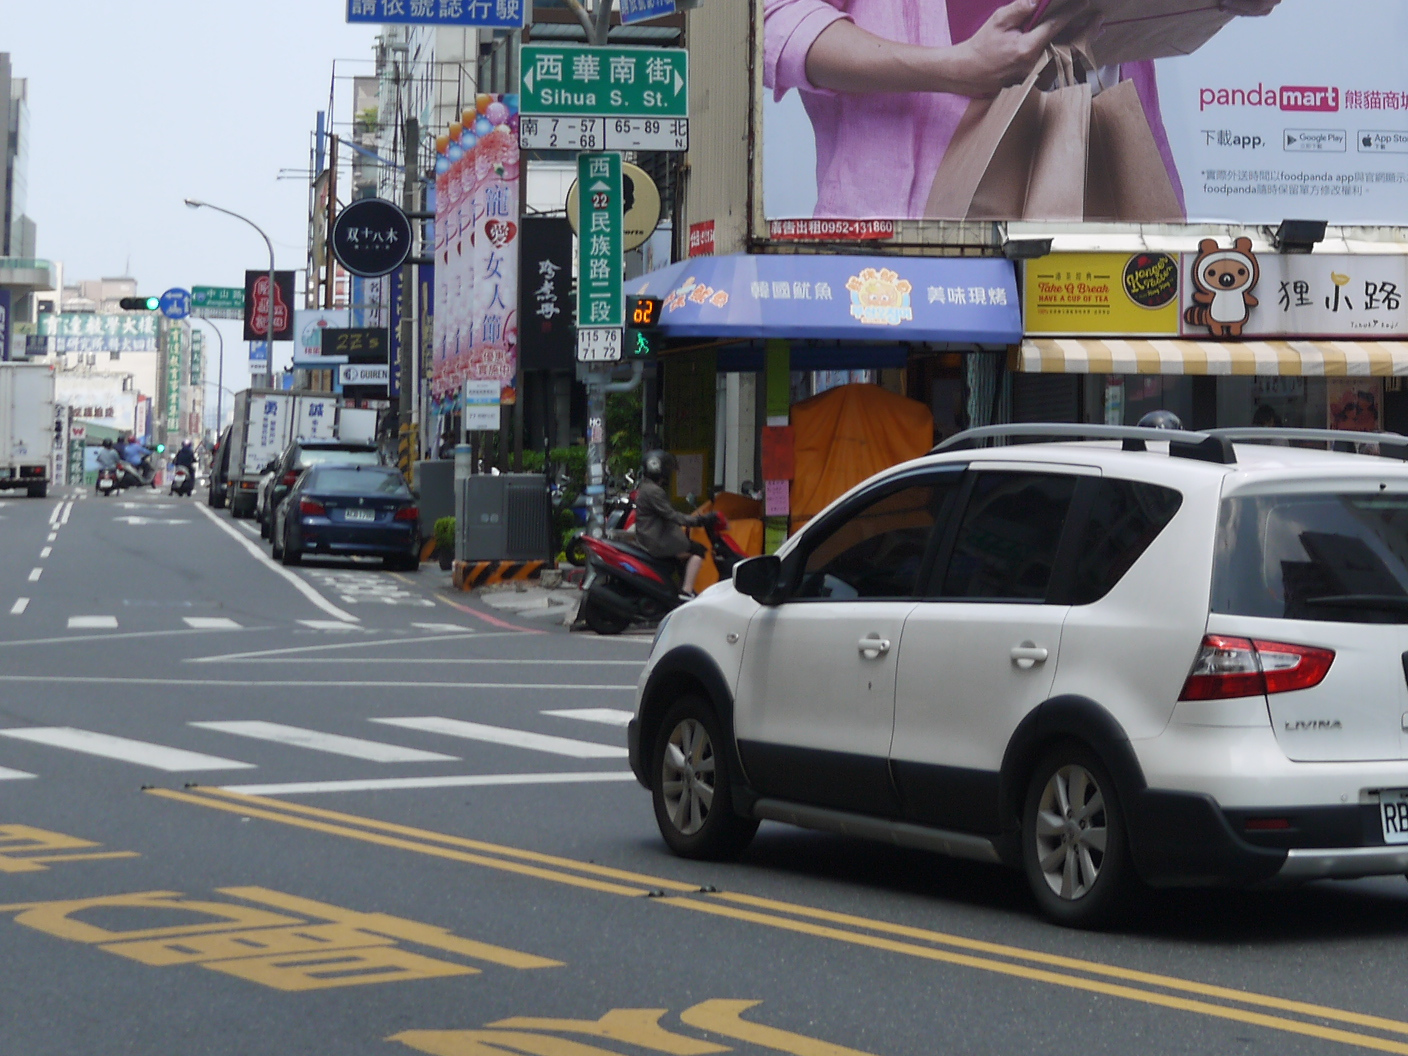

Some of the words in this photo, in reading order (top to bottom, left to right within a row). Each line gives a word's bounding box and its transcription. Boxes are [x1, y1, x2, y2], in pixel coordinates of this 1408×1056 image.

[535, 53, 673, 85] 西華南街
[540, 88, 596, 107] Sihua
[610, 91, 630, 107] S.
[643, 91, 669, 108] St.
[521, 118, 538, 136] 南
[669, 118, 687, 136] 北
[1299, 132, 1327, 144] Google
[1327, 133, 1344, 144] Play
[1374, 134, 1391, 145] App
[589, 157, 610, 178] 西
[592, 194, 609, 208] 22
[589, 212, 611, 323] 民族路二段
[1038, 282, 1063, 294] Take
[1077, 282, 1110, 294] Break
[927, 285, 1007, 306] 美味現烤
[1038, 295, 1058, 303] HAVE
[1060, 295, 1065, 303] A
[1067, 295, 1081, 303] CUP
[1083, 295, 1092, 303] OF
[1095, 295, 1109, 303] TEA
[1278, 280, 1401, 312] 狸小路
[580, 332, 599, 343] 115
[604, 331, 617, 342] 76
[583, 349, 596, 360] 71
[603, 348, 616, 359] 72
[359, 369, 388, 379] GUIREN
[1284, 719, 1343, 731] LIVINA
